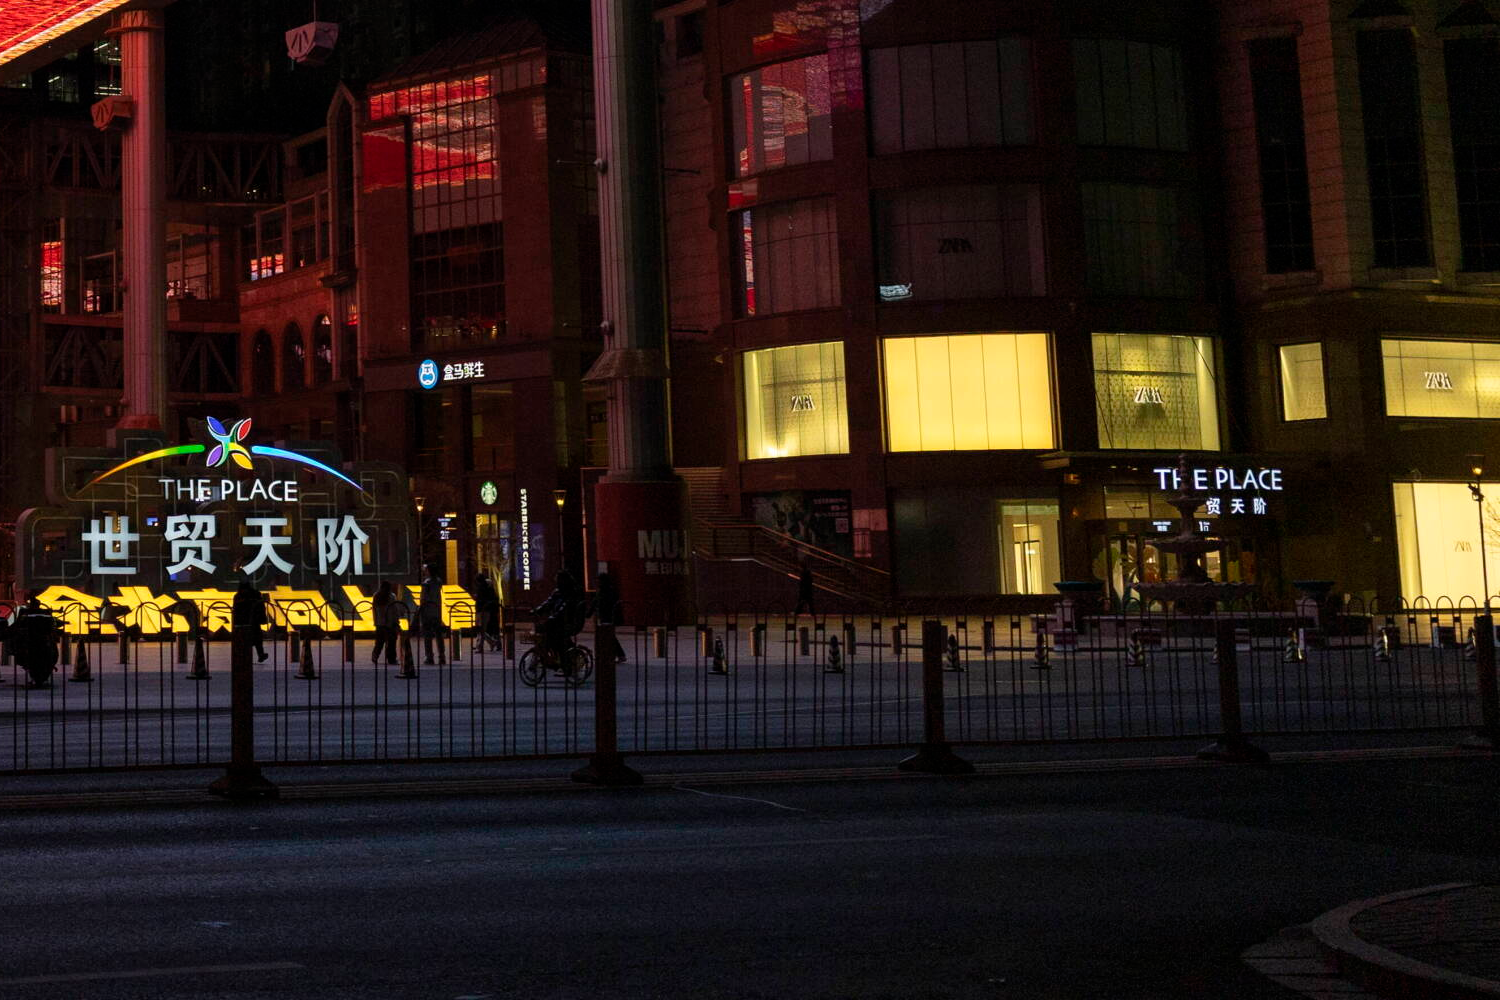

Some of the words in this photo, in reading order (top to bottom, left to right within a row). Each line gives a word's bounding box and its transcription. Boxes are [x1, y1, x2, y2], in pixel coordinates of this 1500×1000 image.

[443, 361, 485, 381] 盒马鲜生
[158, 479, 211, 501] THE
[221, 478, 298, 502] PLACE
[1215, 468, 1283, 490] PLACE
[520, 488, 529, 549] STARBUCKS
[1206, 497, 1268, 515] 贸天阶
[81, 513, 369, 576] 世贸天阶
[637, 529, 690, 560] MUJ
[522, 551, 531, 590] COFFEE
